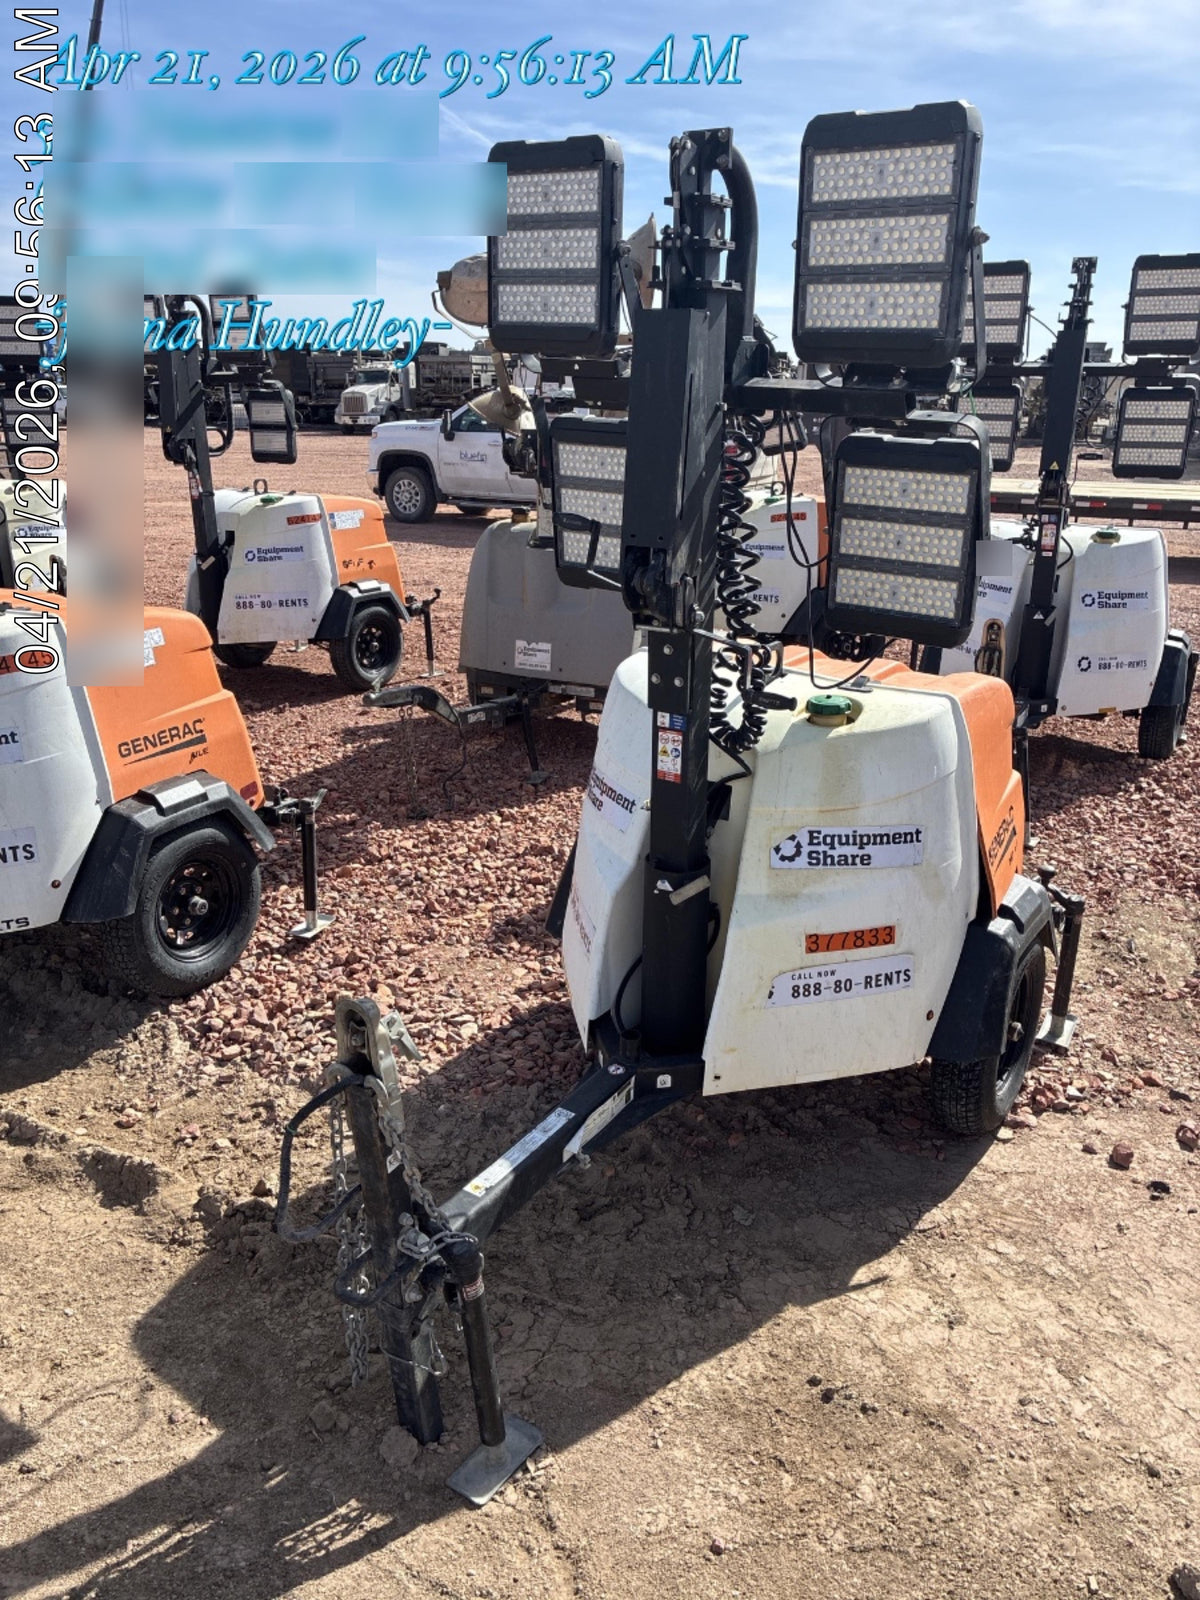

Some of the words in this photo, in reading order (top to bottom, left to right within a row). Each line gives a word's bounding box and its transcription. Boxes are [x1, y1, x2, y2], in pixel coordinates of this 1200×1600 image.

[257, 546, 304, 555] Equipment
[1097, 590, 1149, 601] Equipment
[1097, 600, 1128, 609] Share
[117, 718, 206, 759] GENERAC
[807, 827, 923, 851] Equipment
[807, 850, 873, 867] Share
[807, 925, 894, 953] 377833
[791, 970, 814, 981] CALL
[816, 968, 838, 979] NOW
[791, 968, 912, 999] 888-80-RENTS
